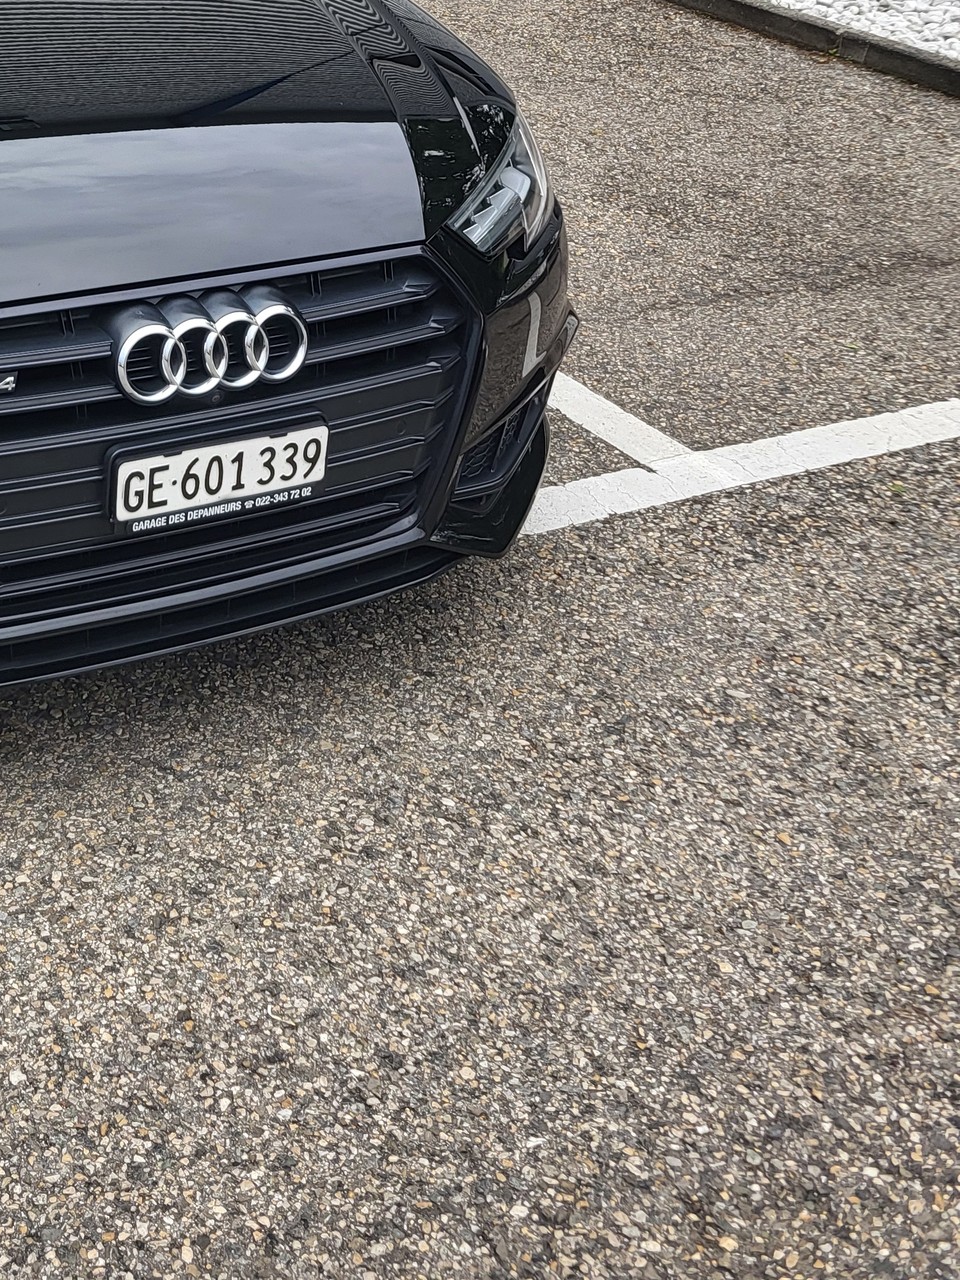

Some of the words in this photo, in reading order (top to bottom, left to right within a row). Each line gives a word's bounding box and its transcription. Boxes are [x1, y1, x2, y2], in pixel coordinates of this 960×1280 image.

[256, 438, 322, 486] 339
[132, 516, 167, 532] GARAGE
[168, 513, 186, 525] DES
[187, 501, 242, 521] DEPANNEURS
[255, 493, 289, 507] 022-343
[290, 488, 300, 499] 72
[301, 486, 312, 497] 02
